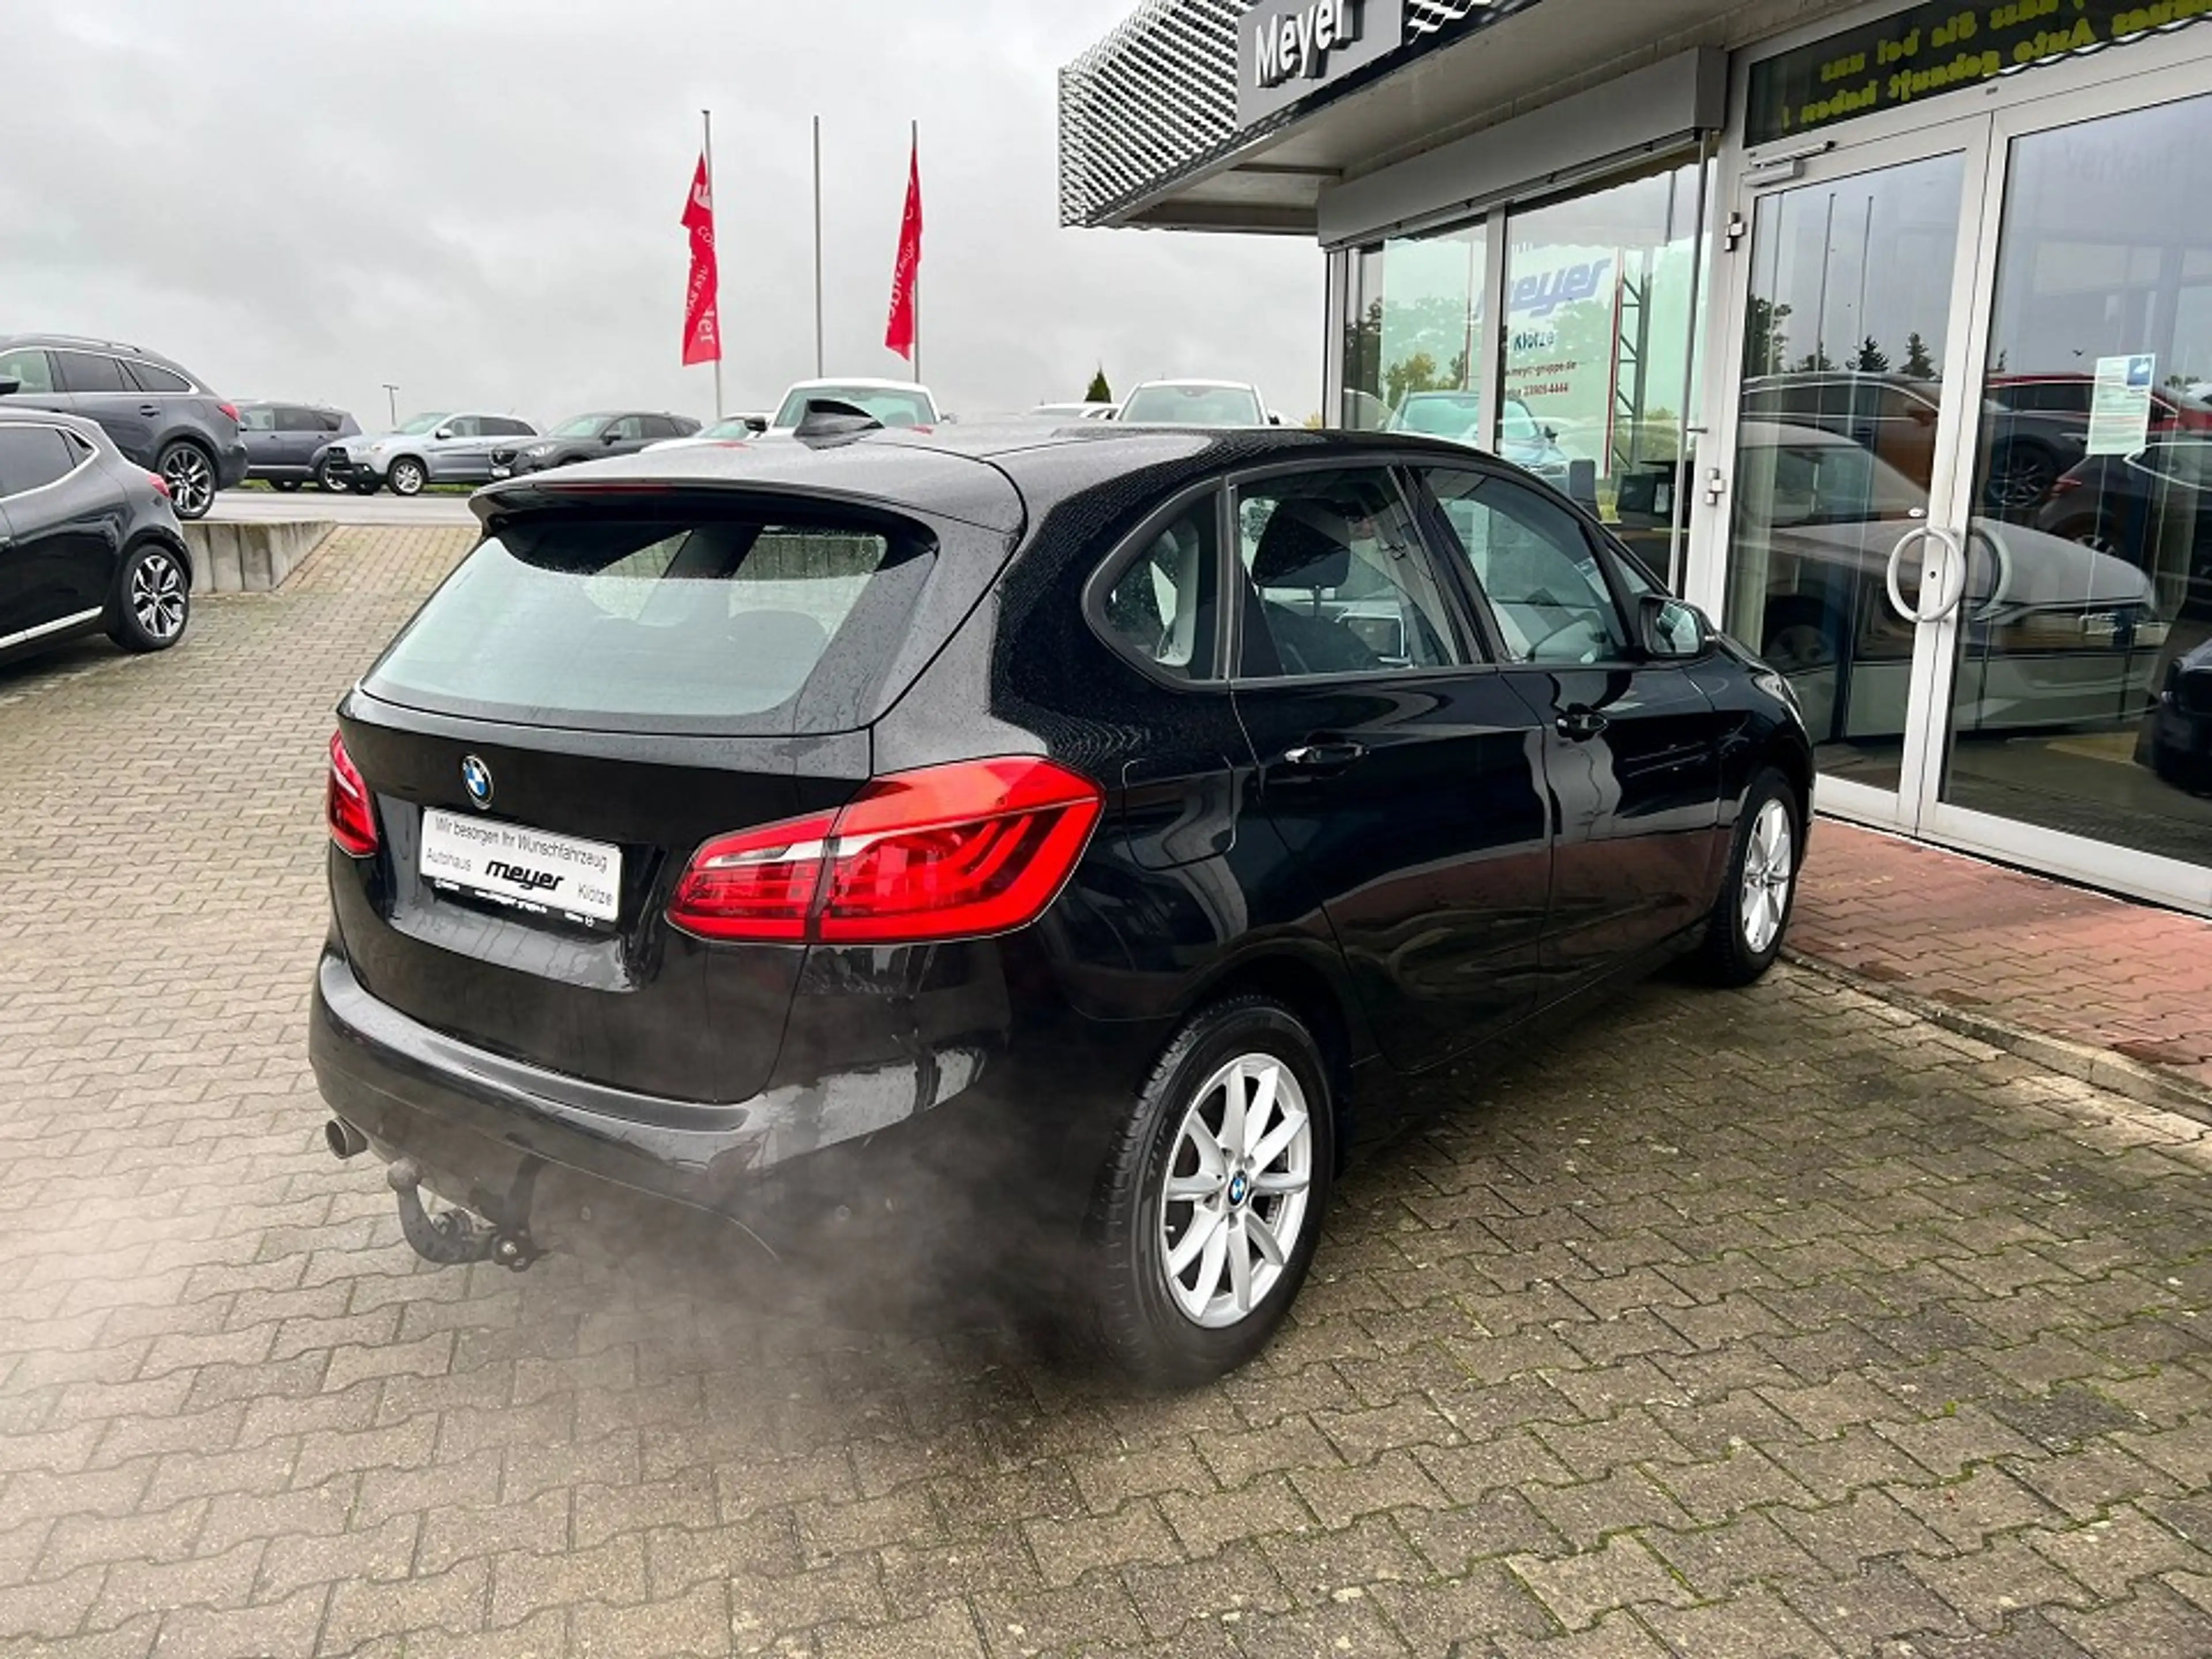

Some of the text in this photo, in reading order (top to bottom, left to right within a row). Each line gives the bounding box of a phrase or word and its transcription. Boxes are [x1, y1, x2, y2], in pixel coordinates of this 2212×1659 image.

[1255, 0, 1344, 86] Meyer
[427, 847, 472, 872] Autohaus
[484, 859, 565, 891] meyer
[435, 816, 608, 874] Wir besorgen Ihr Wunschfahrzeug
